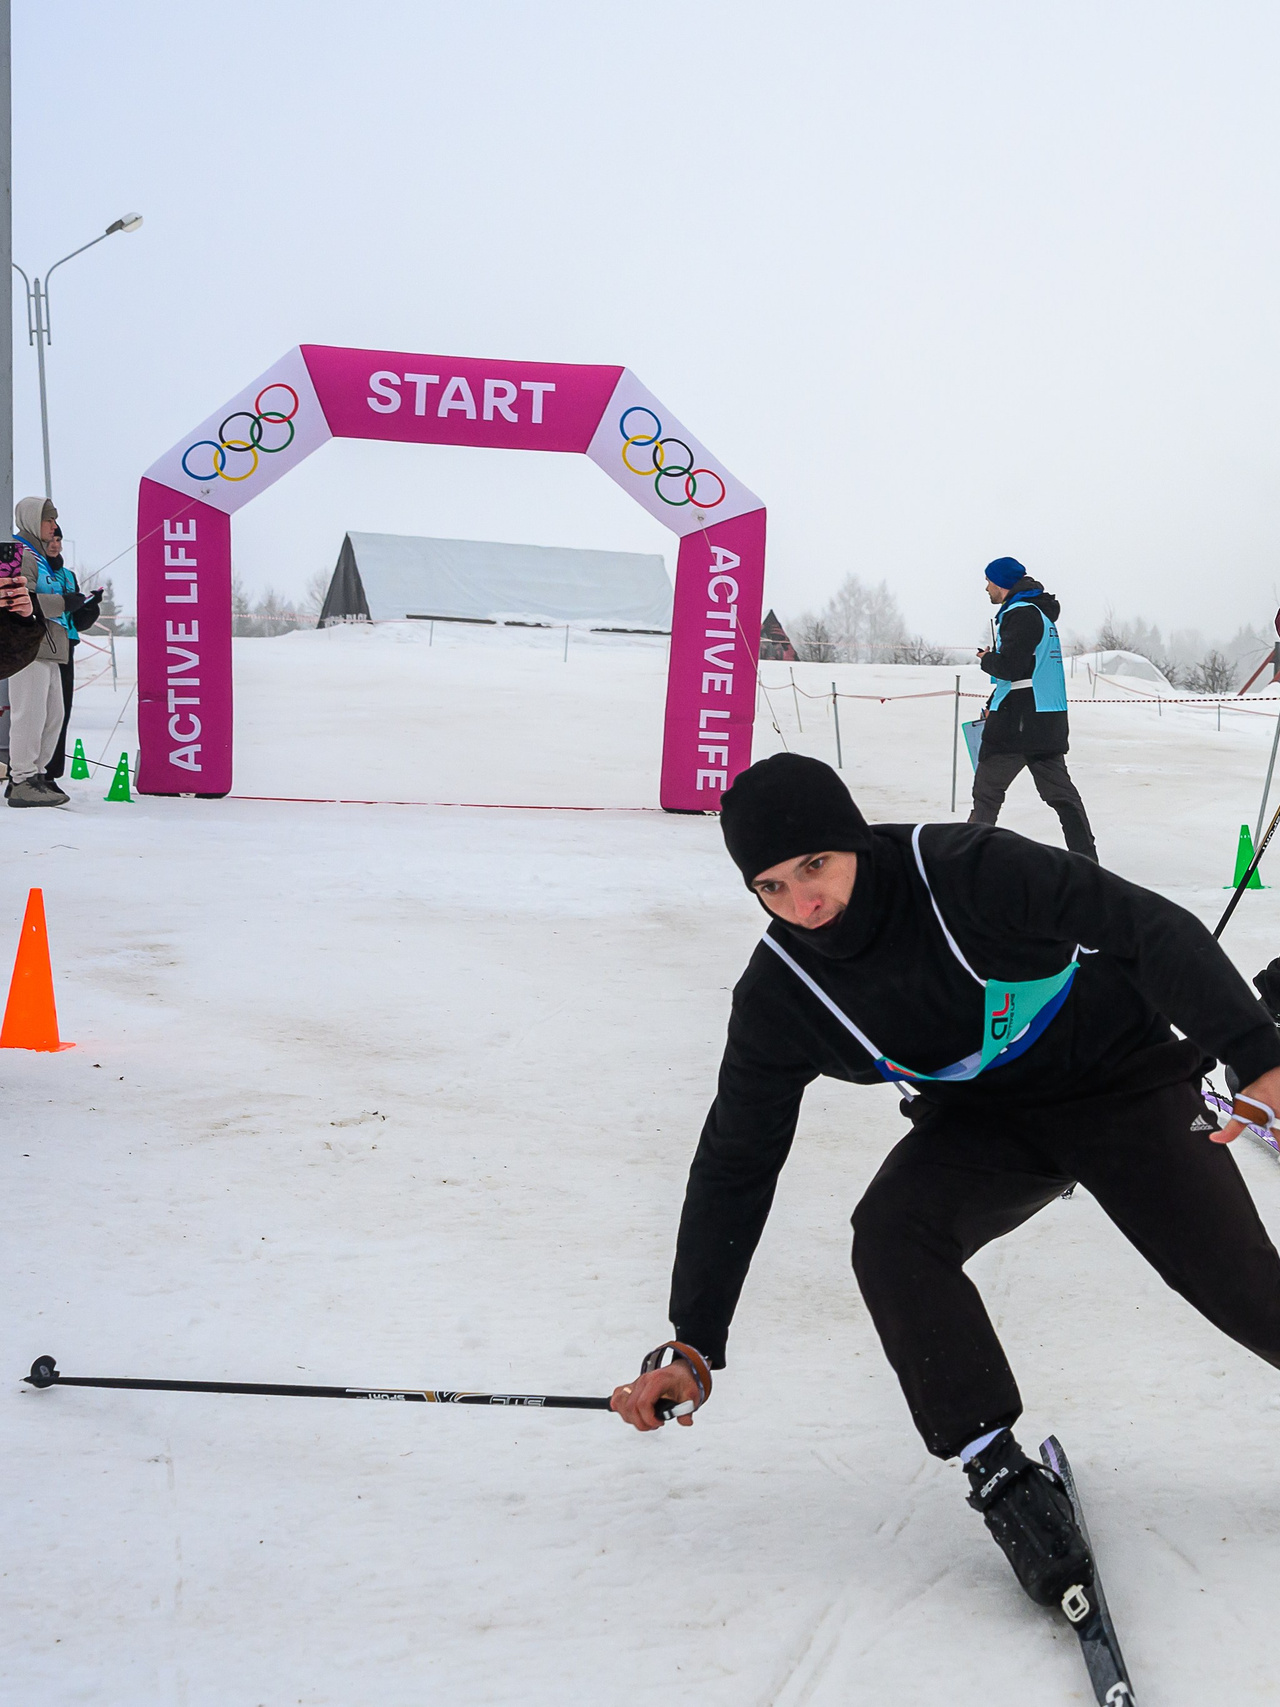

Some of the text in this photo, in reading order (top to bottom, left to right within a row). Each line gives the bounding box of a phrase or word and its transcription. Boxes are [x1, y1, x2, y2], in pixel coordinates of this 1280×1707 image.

[367, 370, 556, 424] START
[164, 519, 202, 772] ACTIVE LIFE
[696, 545, 741, 791] ACTIVE LIFE
[980, 1466, 1010, 1499] alpina
